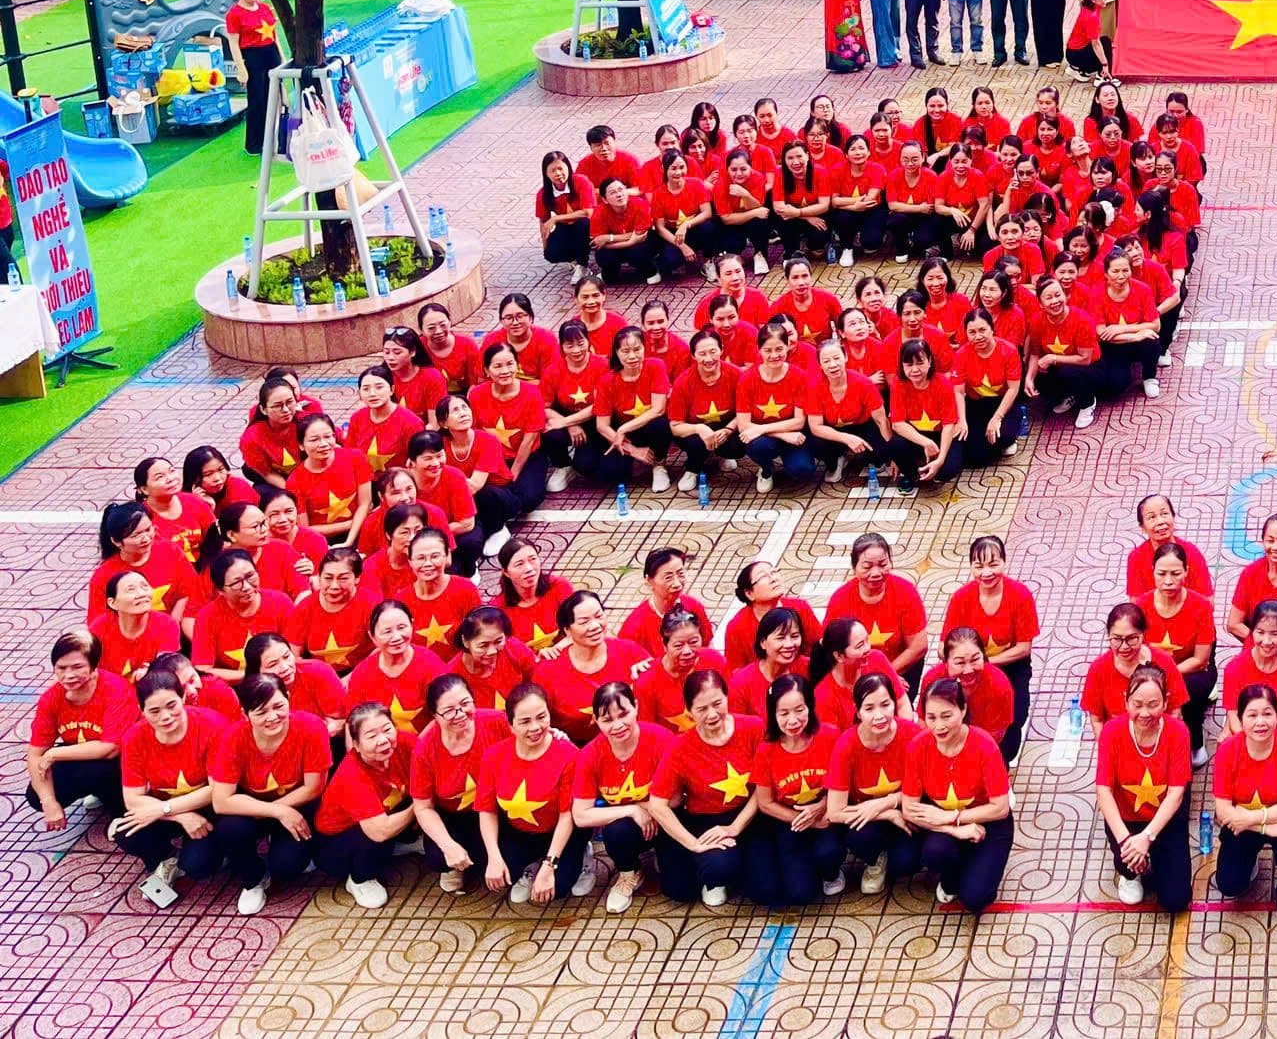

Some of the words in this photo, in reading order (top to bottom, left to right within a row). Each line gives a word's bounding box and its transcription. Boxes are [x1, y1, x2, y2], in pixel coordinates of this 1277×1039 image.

[17, 167, 44, 202] ĐÀO
[43, 157, 69, 192] TẠO
[32, 194, 70, 242] NGHỀ
[49, 239, 70, 273] VÀ
[61, 267, 91, 303] THIỆU
[71, 306, 94, 339] LÀM
